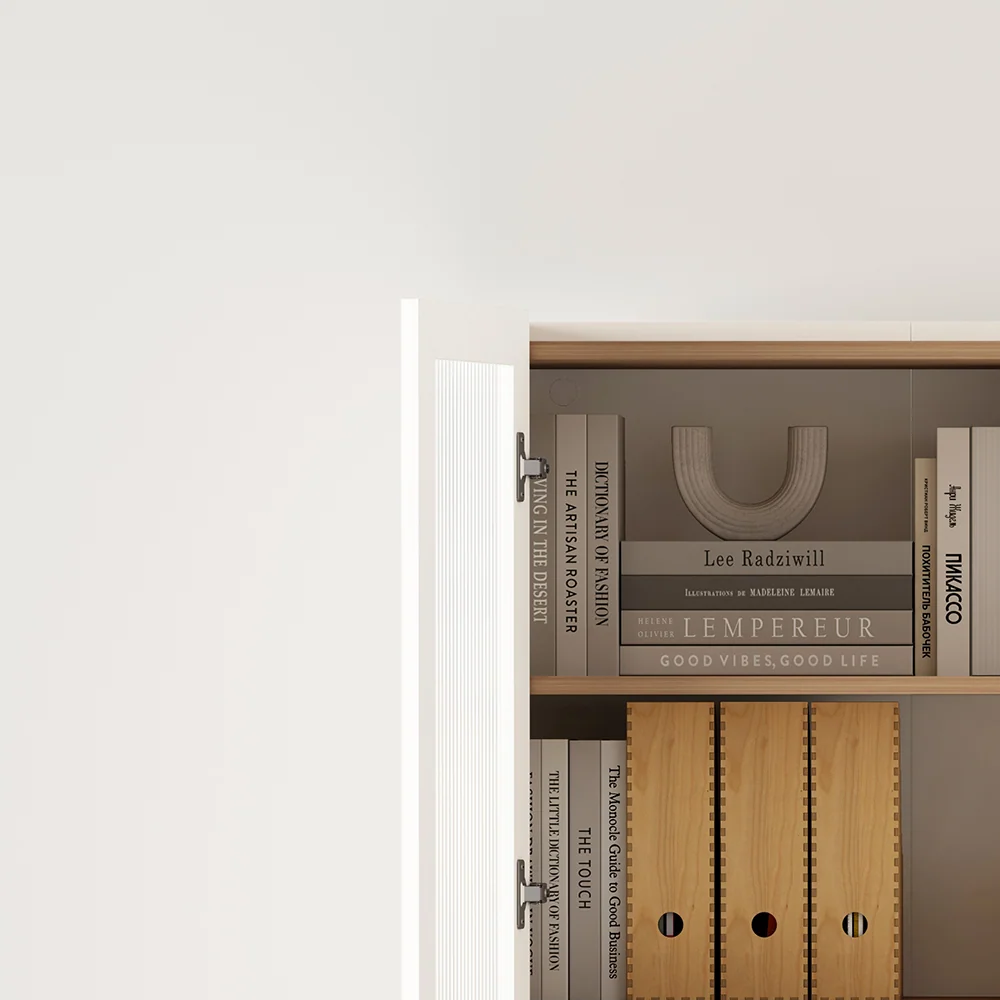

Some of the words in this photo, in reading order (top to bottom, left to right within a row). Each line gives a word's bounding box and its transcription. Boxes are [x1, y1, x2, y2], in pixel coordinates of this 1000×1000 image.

[533, 478, 547, 514] VING
[566, 471, 577, 496] THE
[595, 461, 609, 542] DICTIONARY
[533, 520, 547, 536] IN
[566, 503, 577, 563] ARTISAN
[533, 539, 547, 567] THE
[595, 545, 609, 563] OF
[703, 549, 734, 567] Lee
[742, 549, 825, 567] Radziwill
[750, 588, 795, 597] MADELEINE
[800, 588, 835, 597] LEMAIRE
[922, 545, 931, 610] ПОХИТИТЕЛЬ
[945, 553, 962, 624] ПИКАССО
[533, 571, 547, 624] DESERT
[566, 569, 577, 633] ROASTER
[595, 568, 609, 626] FASHION
[683, 617, 874, 638] LEMPEREUR
[922, 612, 931, 659] БАБОЧЕК
[660, 654, 712, 667] GOOD
[780, 654, 832, 667] GOOD
[841, 654, 879, 667] LIFE
[549, 771, 559, 793] THE
[609, 765, 621, 788] The
[549, 796, 559, 836] LITTLE
[608, 792, 621, 840] Monocle
[578, 828, 591, 854] THE
[548, 839, 559, 905] DICTIONARY
[608, 844, 621, 878] Guide
[578, 860, 591, 909] TOUCH
[608, 882, 619, 893] to
[548, 905, 559, 920] OF
[608, 896, 621, 927] Good
[548, 923, 559, 971] FASHION
[608, 931, 621, 979] Business
